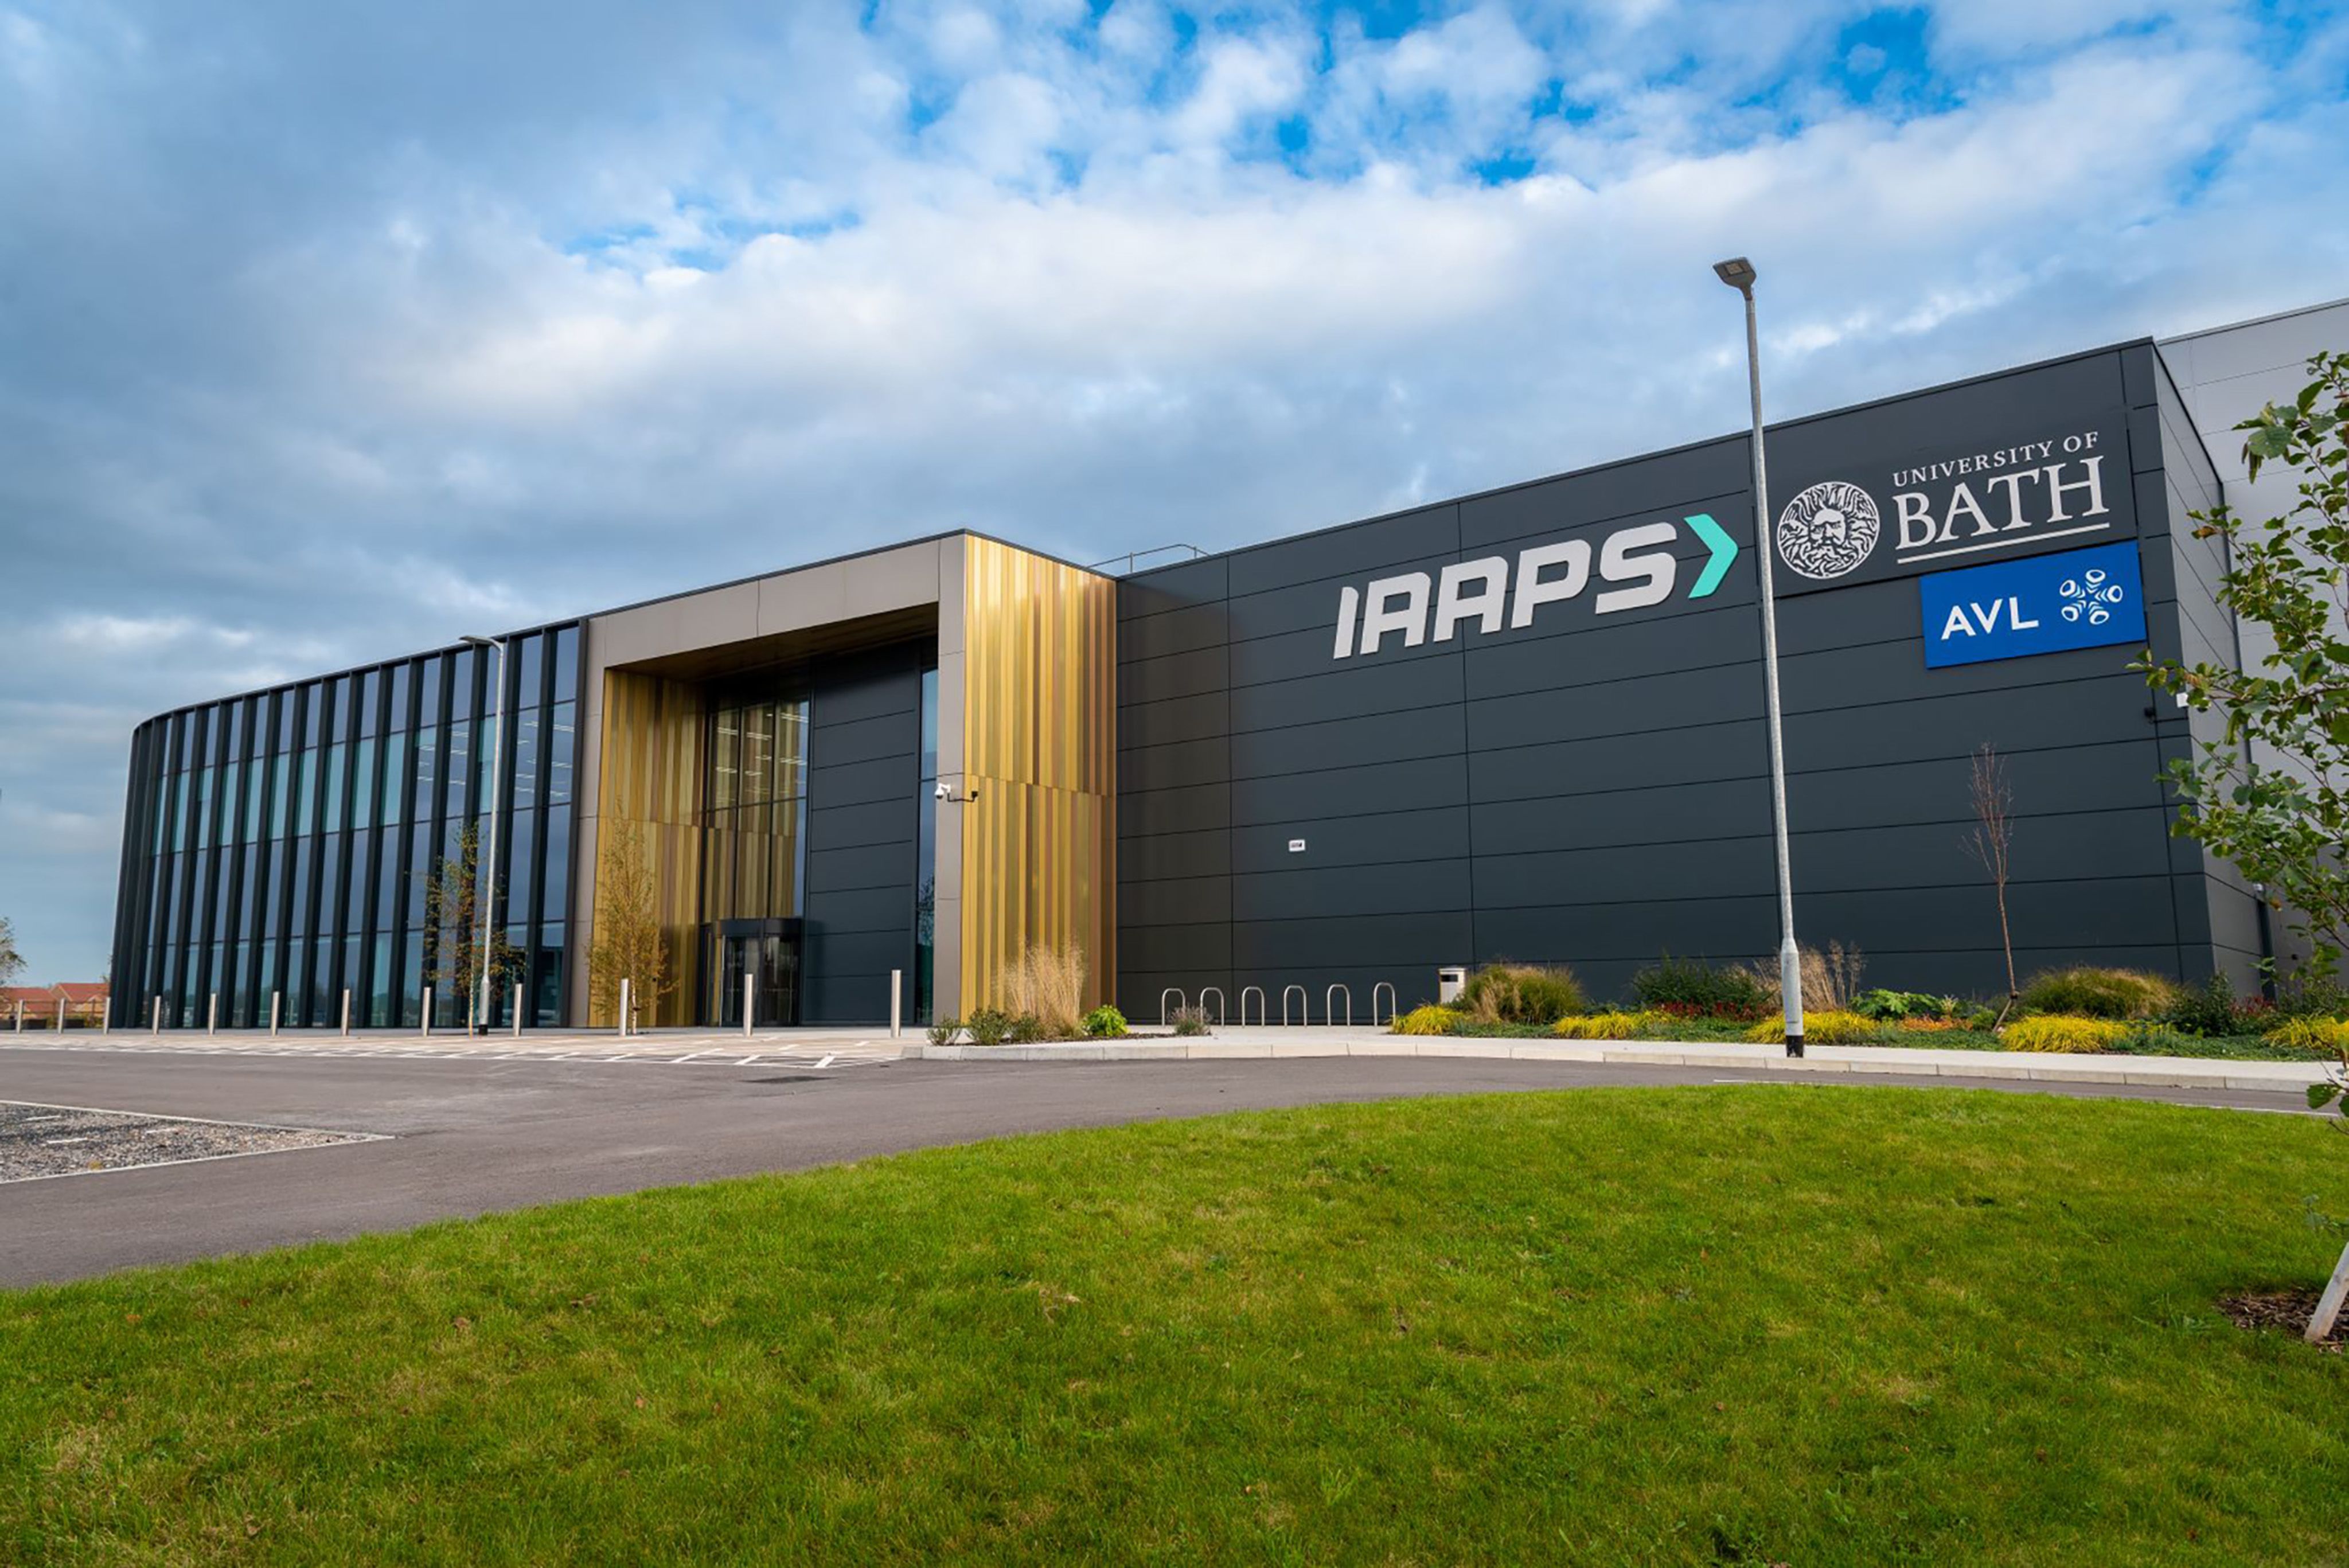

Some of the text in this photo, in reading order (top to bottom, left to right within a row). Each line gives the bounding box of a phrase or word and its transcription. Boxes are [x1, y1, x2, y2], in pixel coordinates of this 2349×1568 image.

[1893, 431, 2099, 487] UNIVERSITY OF
[1892, 455, 2110, 551] BATH
[1333, 522, 1677, 659] IAAPS
[1941, 597, 2039, 640] AVL
